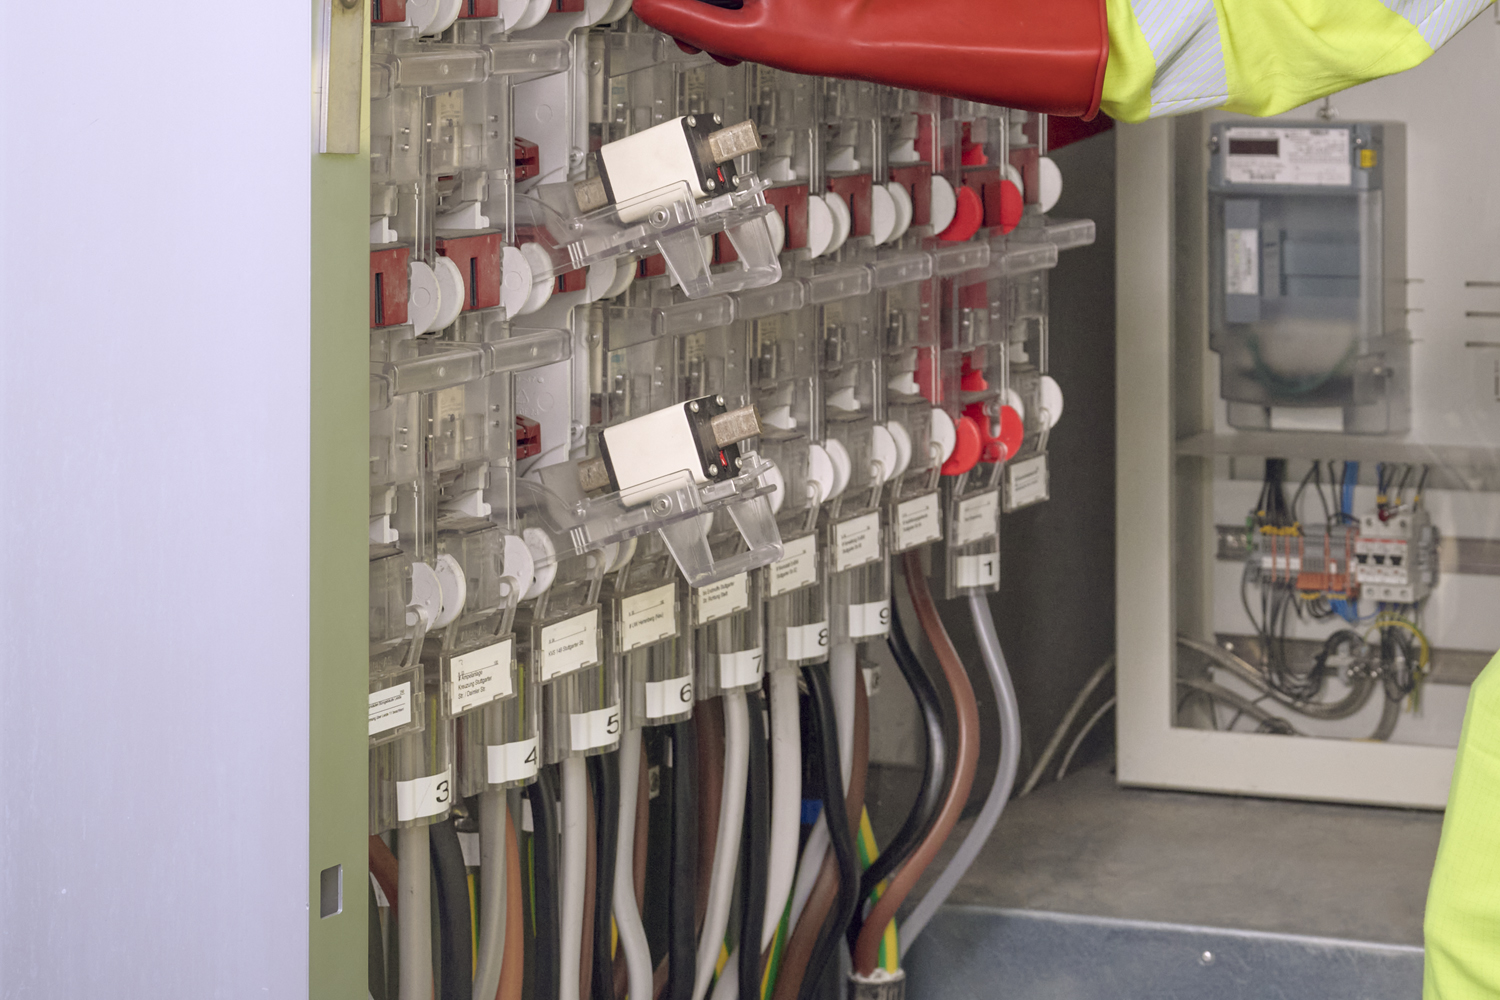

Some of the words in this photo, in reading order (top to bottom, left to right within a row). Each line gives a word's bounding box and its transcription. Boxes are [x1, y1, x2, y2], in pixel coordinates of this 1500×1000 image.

[879, 607, 889, 625] 9
[818, 628, 828, 647] 8
[752, 654, 762, 674] 7
[679, 683, 692, 703] 6
[606, 712, 620, 734] 5
[524, 745, 537, 766] 4
[436, 780, 450, 803] 3
